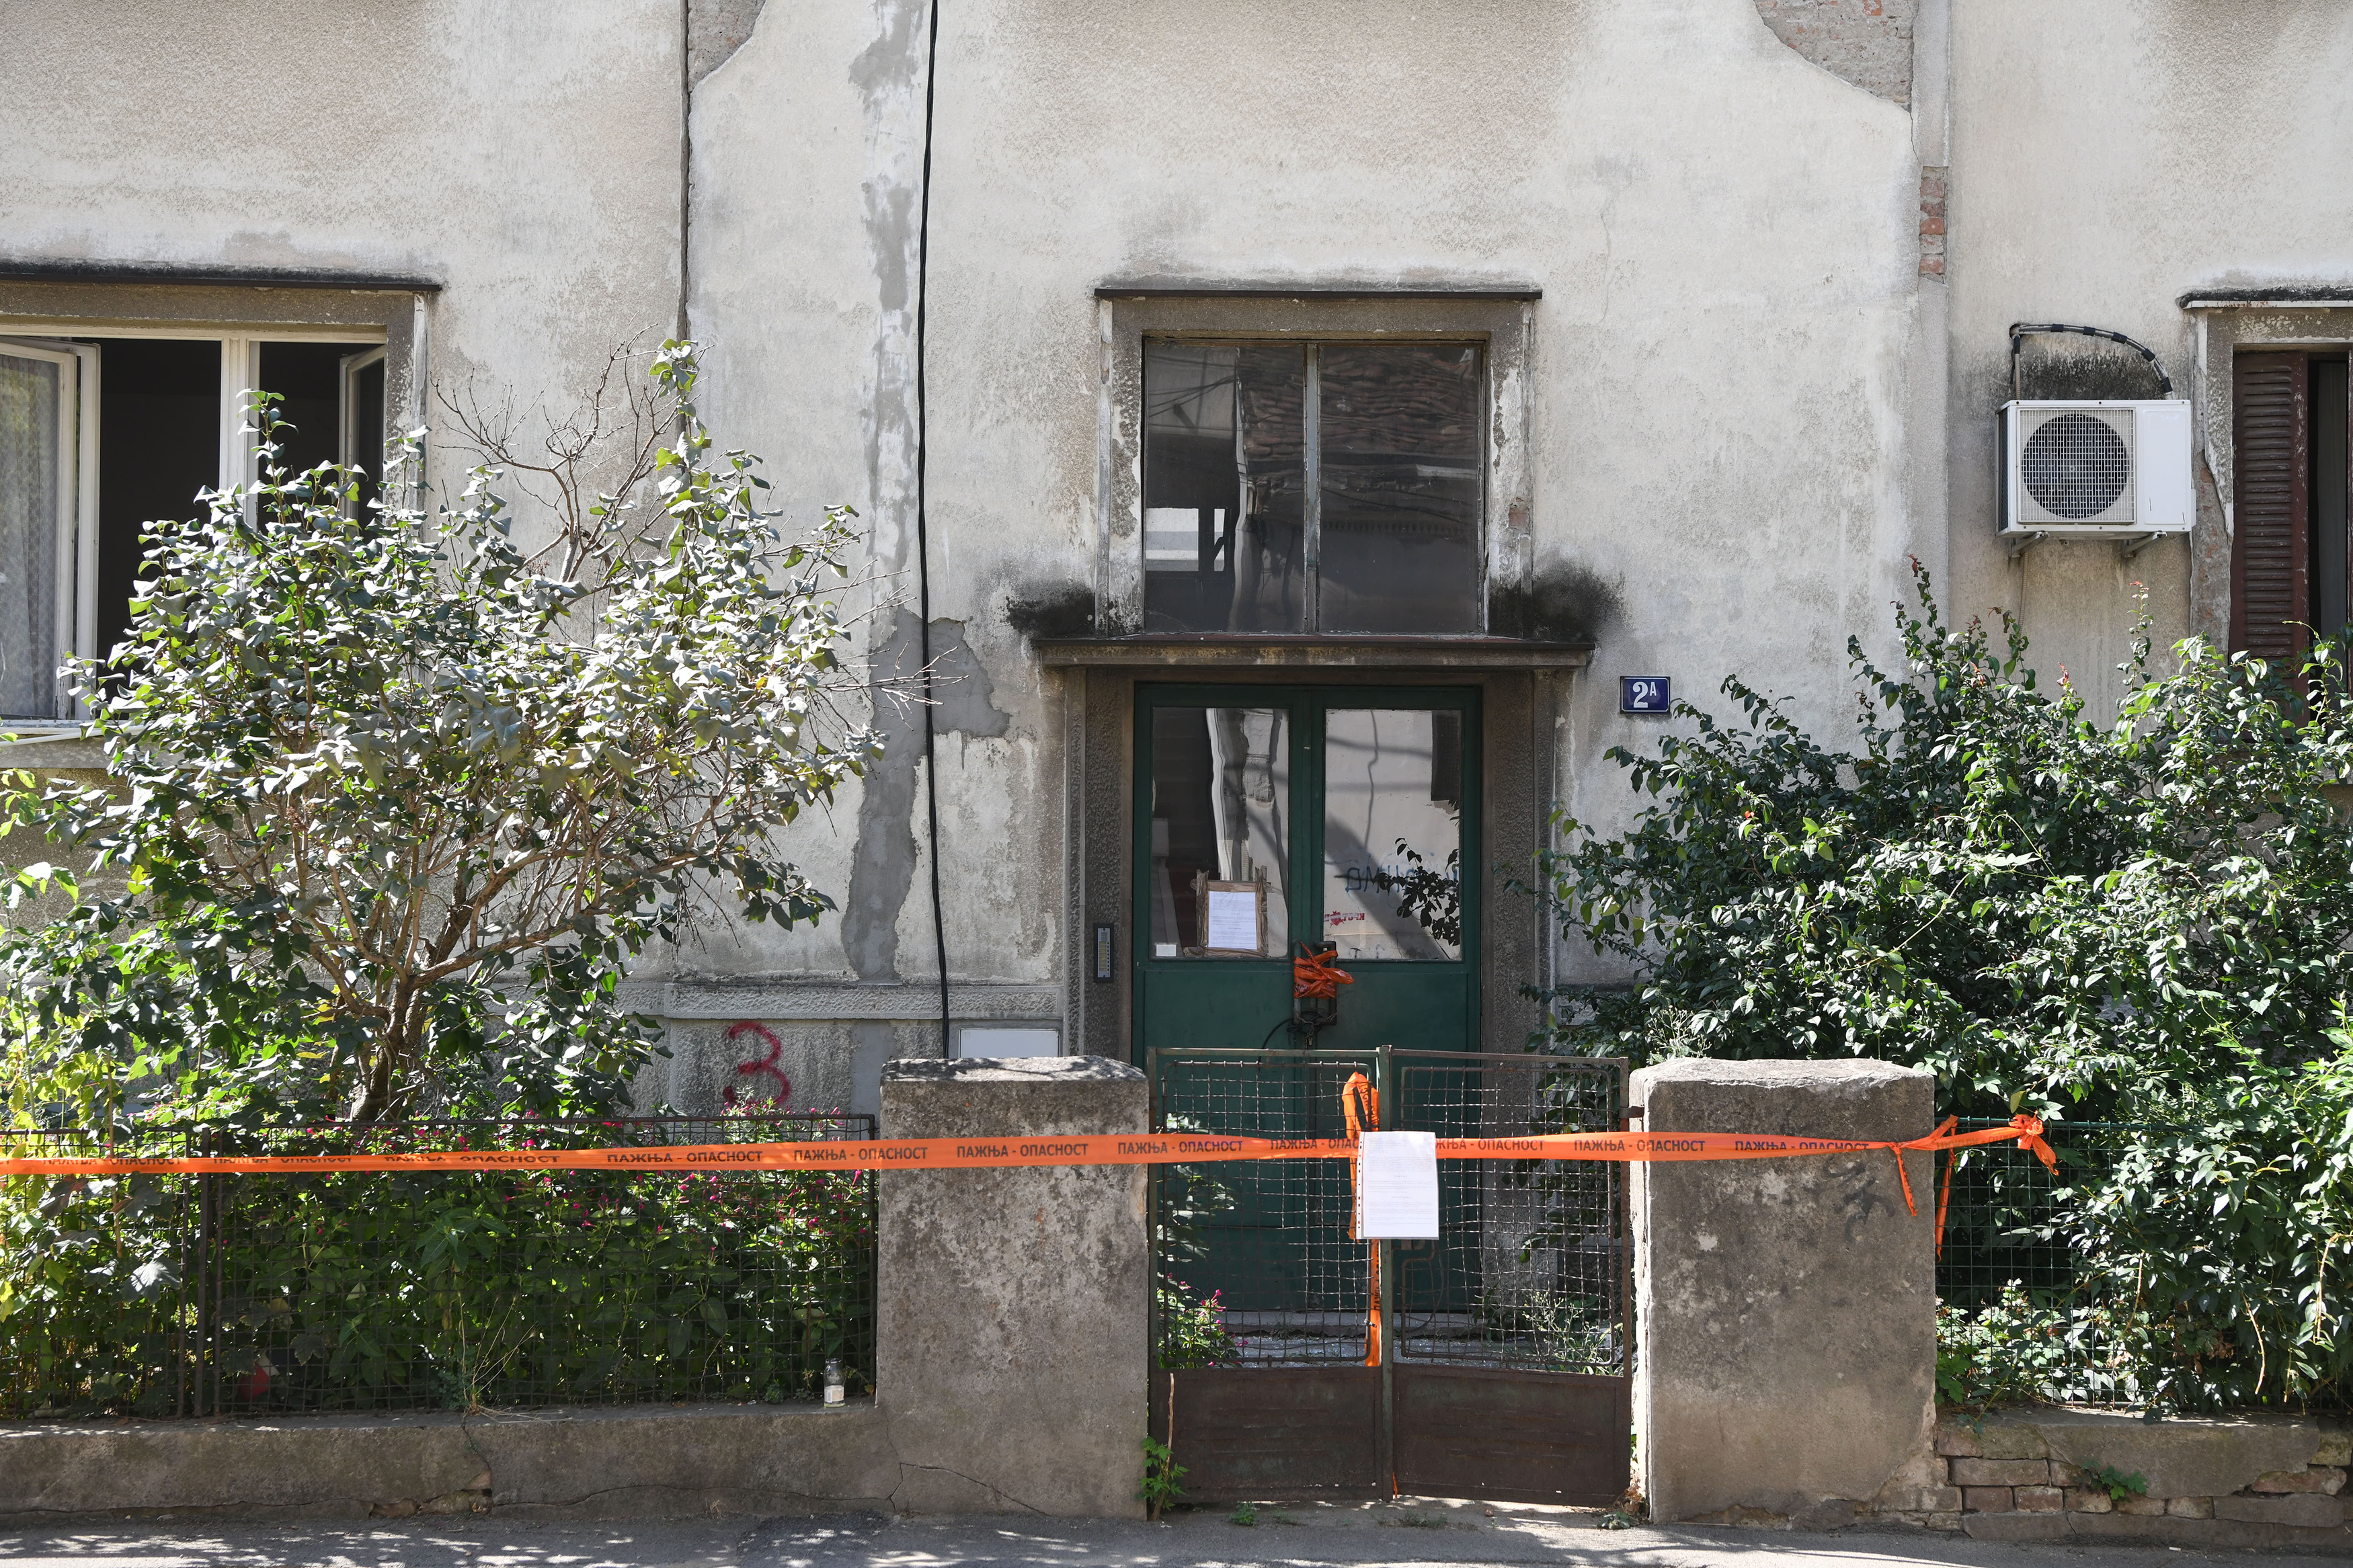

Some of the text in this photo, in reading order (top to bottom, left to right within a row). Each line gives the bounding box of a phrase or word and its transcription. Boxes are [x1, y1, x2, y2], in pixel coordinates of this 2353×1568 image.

[957, 1145, 1008, 1158] ПАЖЊА
[1021, 1143, 1088, 1157] ОПАСНОСТ
[1117, 1142, 1168, 1155] ПАЖЊА
[1179, 1139, 1243, 1153] ОПАСНОСТ
[1270, 1138, 1318, 1150] ПАЖЊА
[1478, 1138, 1545, 1151] ОПАСНОСТ
[1574, 1139, 1626, 1152] ПАЖЊА
[1637, 1139, 1706, 1153] ОПАСНОСТ
[1735, 1141, 1786, 1151] ПАЖЊА
[1799, 1141, 1869, 1150] ОПАСНОСТ
[606, 1153, 673, 1163] ПАЖЊА
[686, 1150, 763, 1163] ОПАСНОСТ
[794, 1149, 847, 1161] ПАЖЊА
[859, 1147, 928, 1160] ОПАСНОСТ
